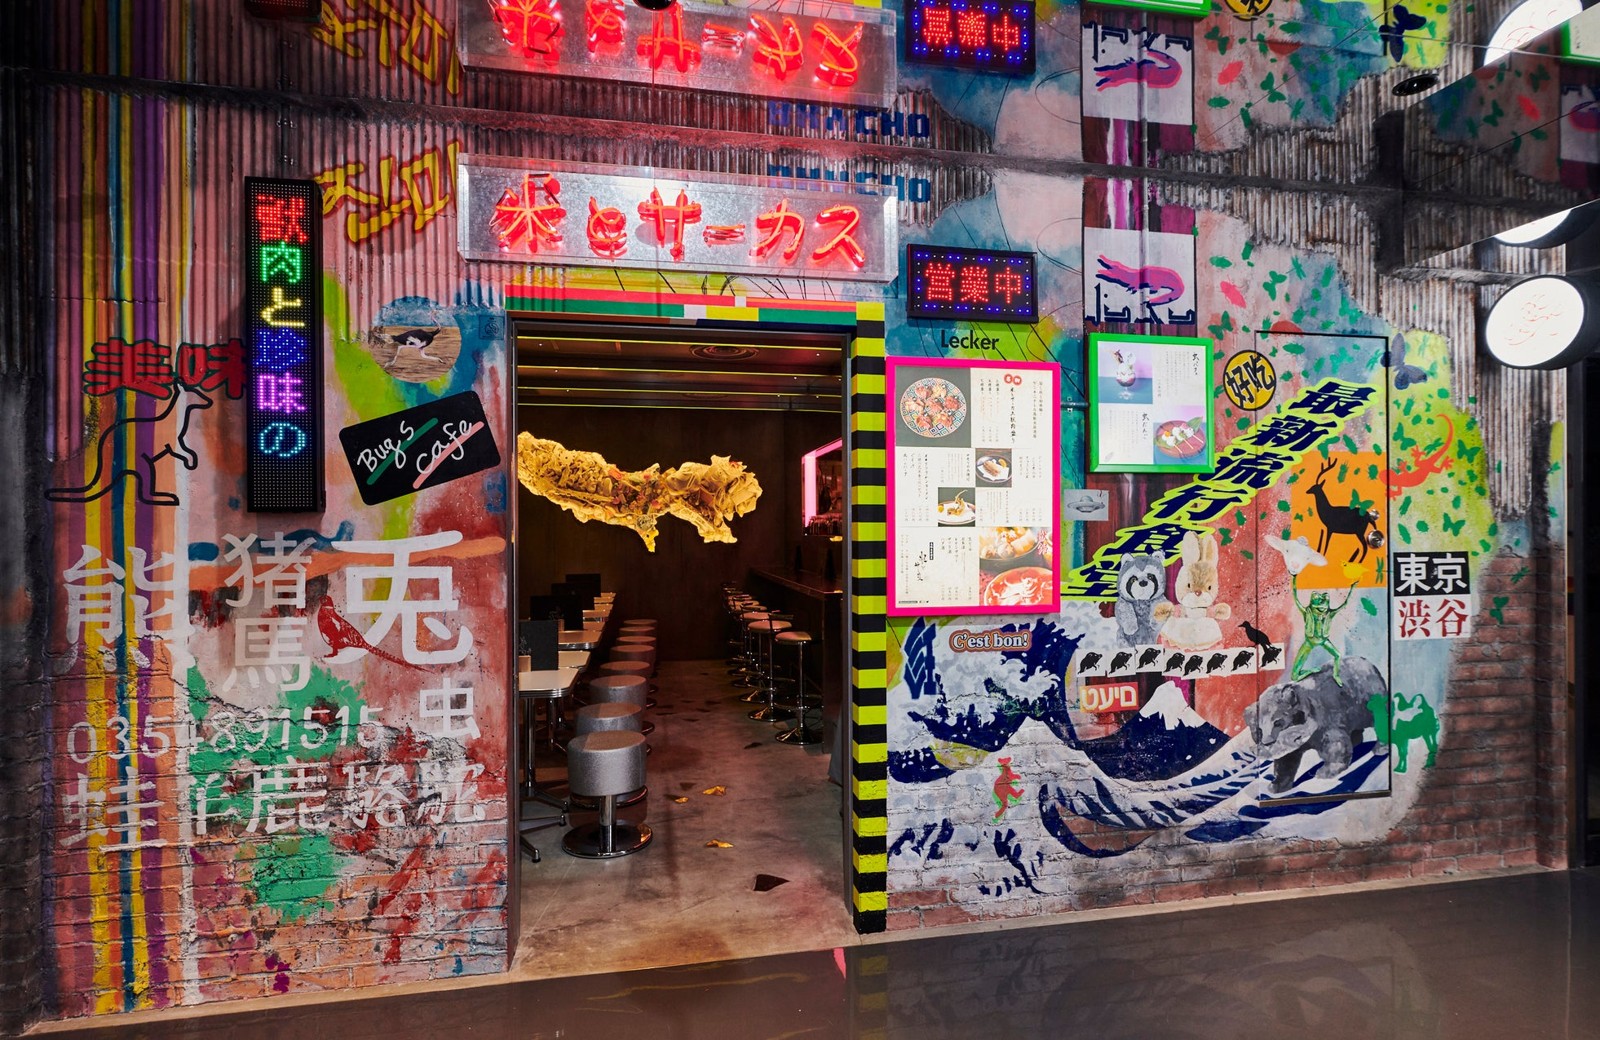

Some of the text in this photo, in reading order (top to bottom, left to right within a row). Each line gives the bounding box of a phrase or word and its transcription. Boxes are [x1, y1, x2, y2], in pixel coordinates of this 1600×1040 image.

[490, 173, 866, 268] 米とサーカス
[924, 263, 1023, 303] 営業中
[940, 329, 1000, 351] Lecker
[83, 337, 247, 401] 美味
[1227, 355, 1276, 405] 好吃
[357, 420, 415, 473] Bugs
[1395, 557, 1468, 593] 東京
[62, 544, 197, 680] 熊
[1399, 602, 1469, 637] 渋谷
[223, 617, 312, 692] 馬
[953, 632, 1029, 649] C'est bon!
[419, 677, 481, 740] 虫
[1081, 686, 1138, 710] טעים
